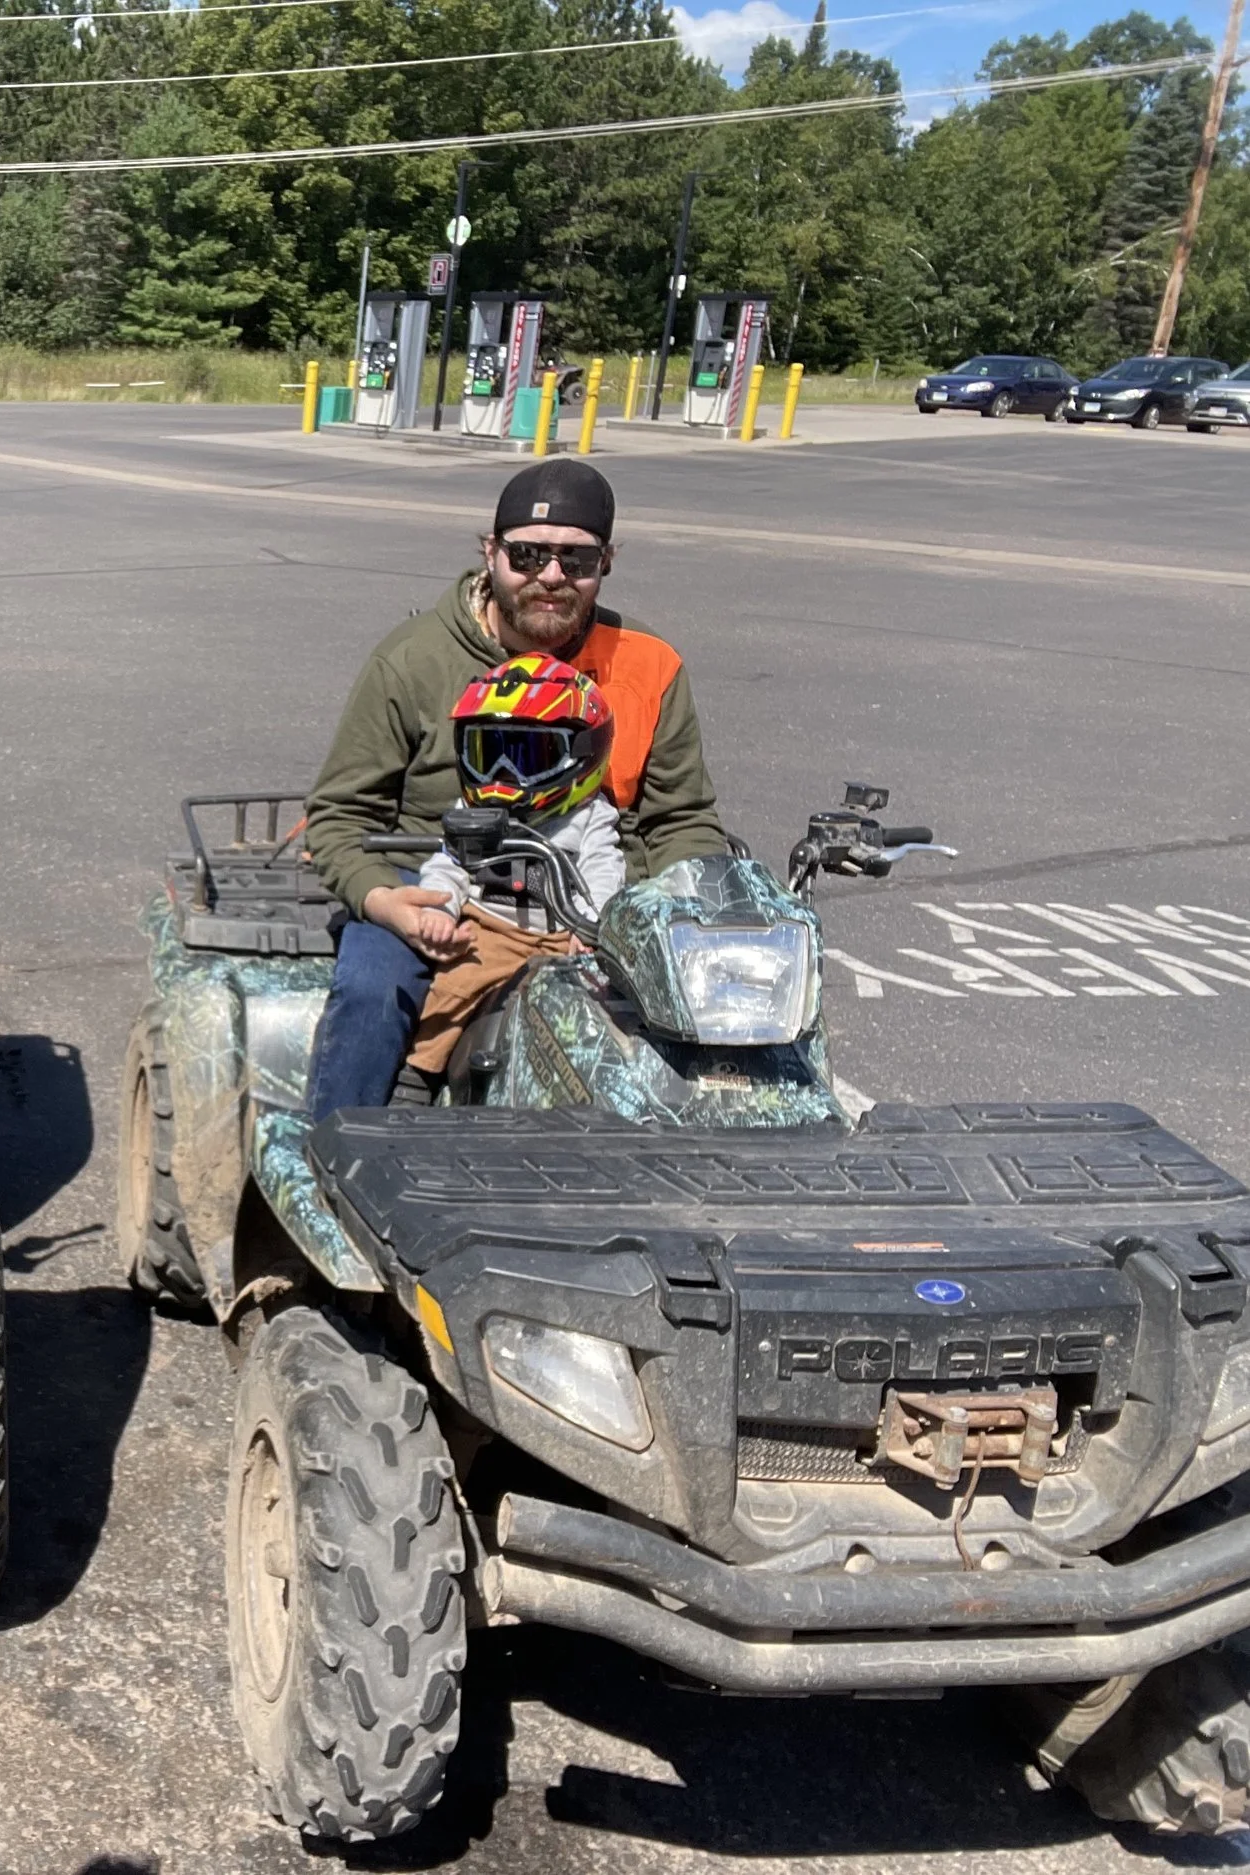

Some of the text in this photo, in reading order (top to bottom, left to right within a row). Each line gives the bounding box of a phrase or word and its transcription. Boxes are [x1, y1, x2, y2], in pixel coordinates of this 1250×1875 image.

[526, 1006, 592, 1105] SPORTSMAN
[528, 1044, 552, 1087] 500
[777, 1332, 1101, 1383] POLARIS
